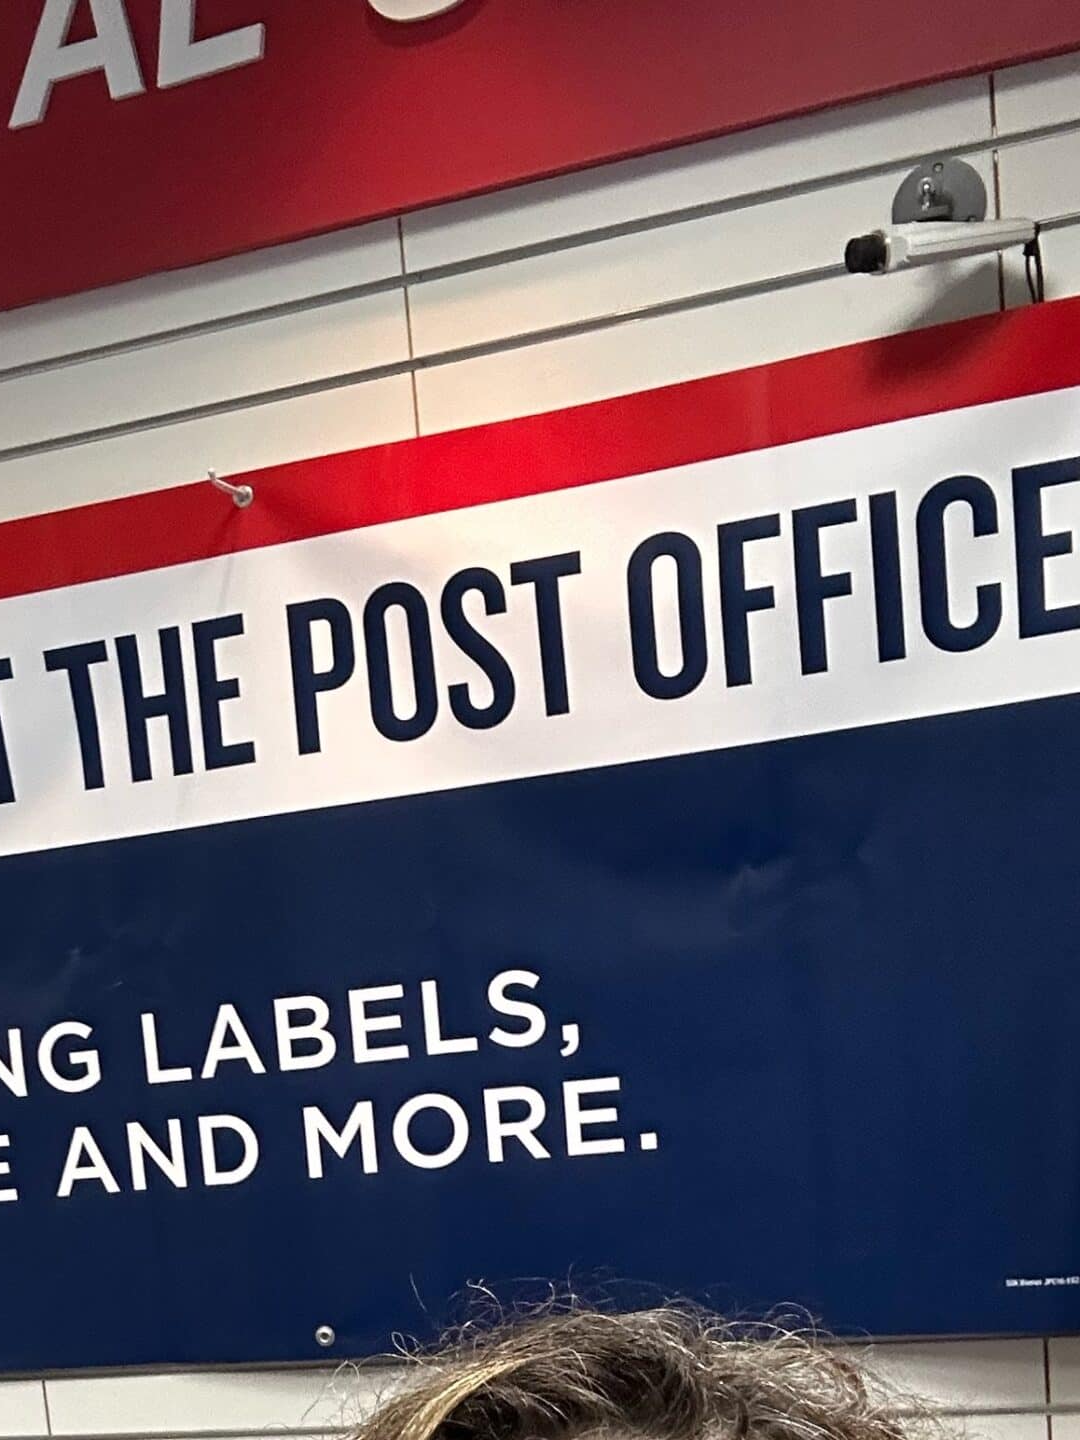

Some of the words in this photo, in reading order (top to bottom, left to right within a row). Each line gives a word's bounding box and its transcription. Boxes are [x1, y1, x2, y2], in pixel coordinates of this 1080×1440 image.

[43, 614, 255, 790] THE
[286, 551, 581, 755] POST
[627, 456, 1080, 700] OFFICE
[142, 970, 579, 1083] LABELS,
[58, 1115, 258, 1196] AND
[304, 1077, 657, 1178] MORE.
